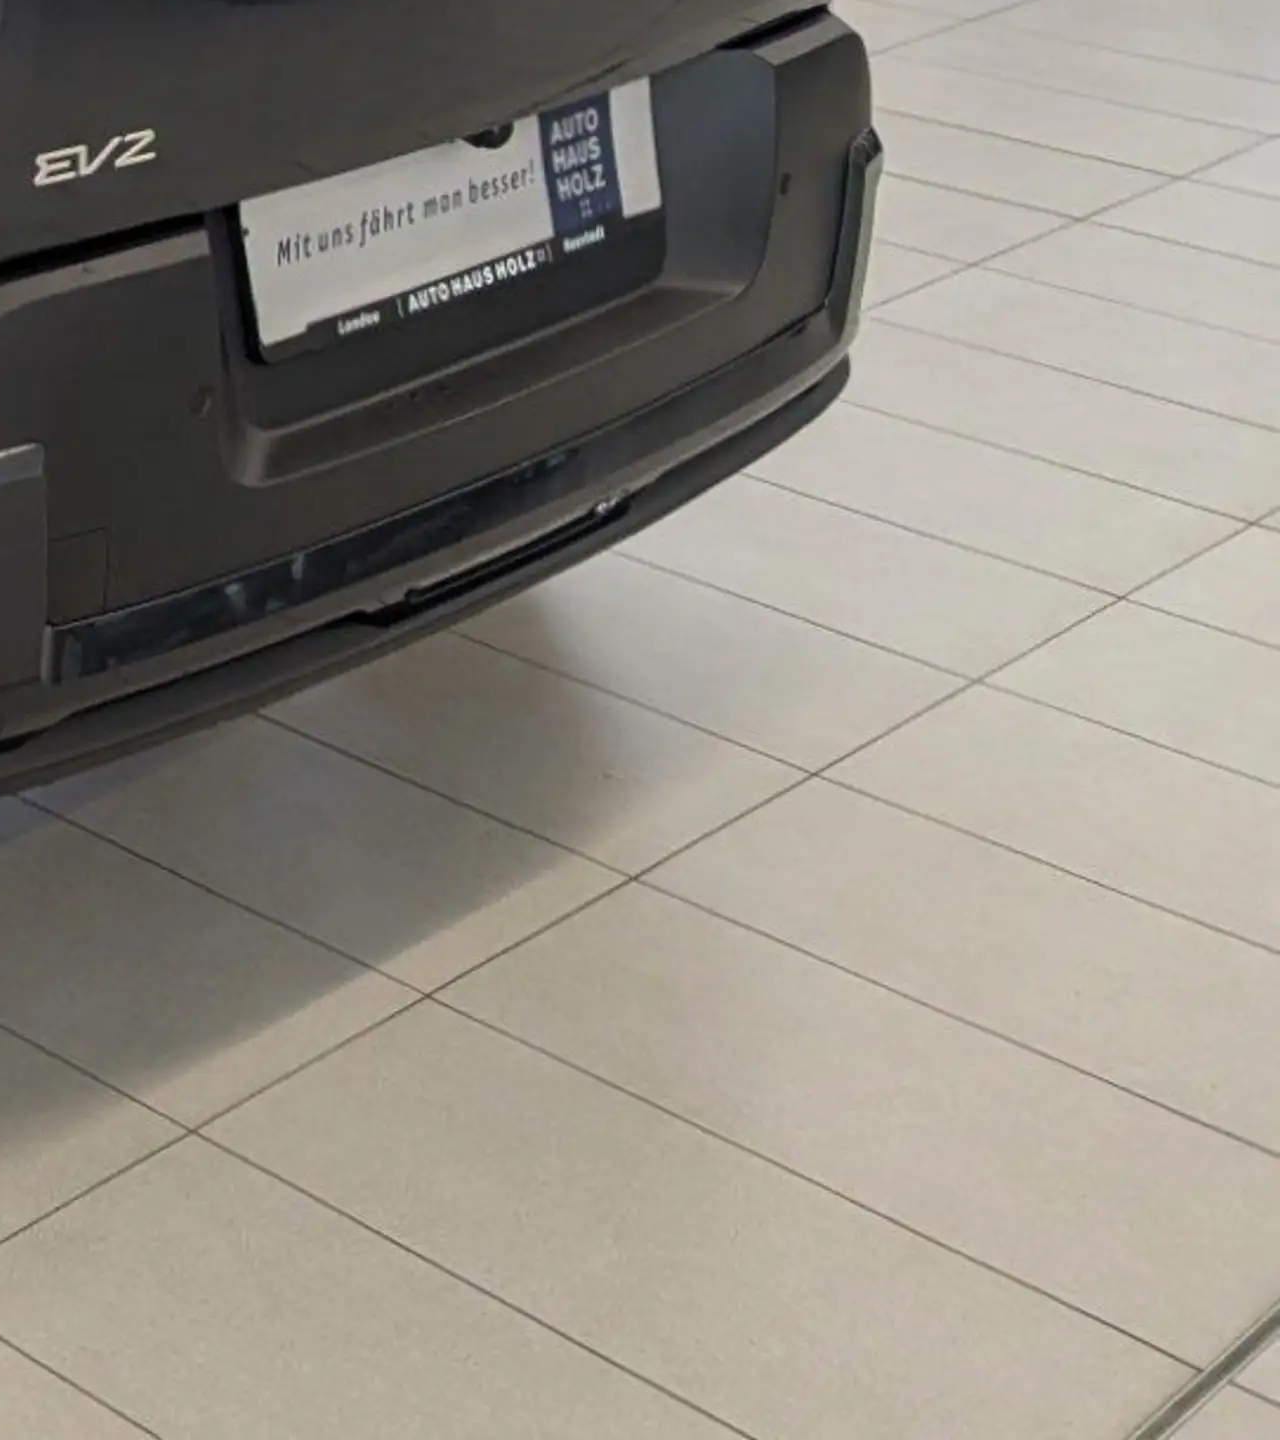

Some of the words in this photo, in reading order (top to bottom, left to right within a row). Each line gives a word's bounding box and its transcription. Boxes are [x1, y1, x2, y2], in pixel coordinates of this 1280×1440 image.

[550, 108, 599, 145] AUTO
[34, 127, 157, 187] EV2
[552, 136, 601, 173] HAUS
[556, 164, 607, 202] HOLZ
[277, 232, 312, 267] Mit
[317, 222, 355, 252] uns
[359, 201, 415, 248] fährt
[423, 188, 463, 218] man
[468, 157, 536, 205] besser!
[495, 249, 536, 281] HOLZ
